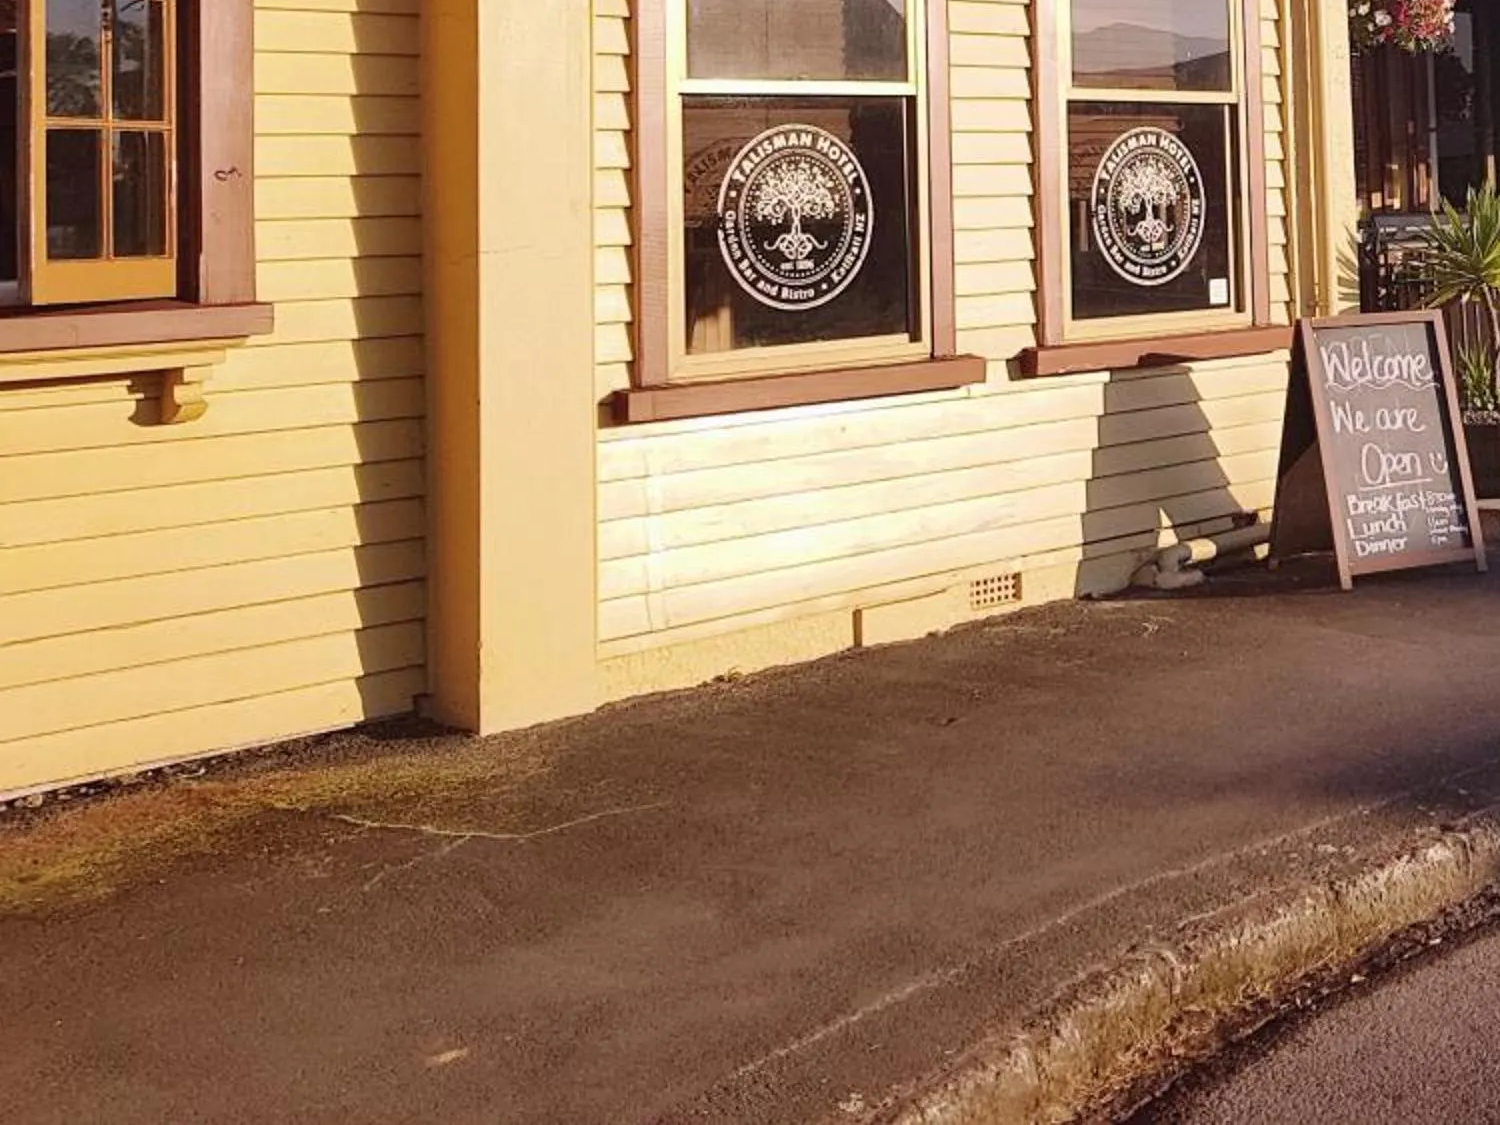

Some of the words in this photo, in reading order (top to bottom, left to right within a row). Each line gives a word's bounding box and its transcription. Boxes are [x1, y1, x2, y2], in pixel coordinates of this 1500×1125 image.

[732, 132, 813, 182] TALISMAN
[816, 136, 858, 185] HOTEL
[1101, 134, 1157, 180] TALISMAN
[1159, 135, 1191, 174] HOTEL
[1320, 341, 1434, 385] Welcome
[1330, 400, 1372, 434] We
[1375, 407, 1427, 432] are
[1361, 442, 1422, 486] Open
[1347, 513, 1407, 540] Lunch
[1356, 536, 1408, 556] Dinner
